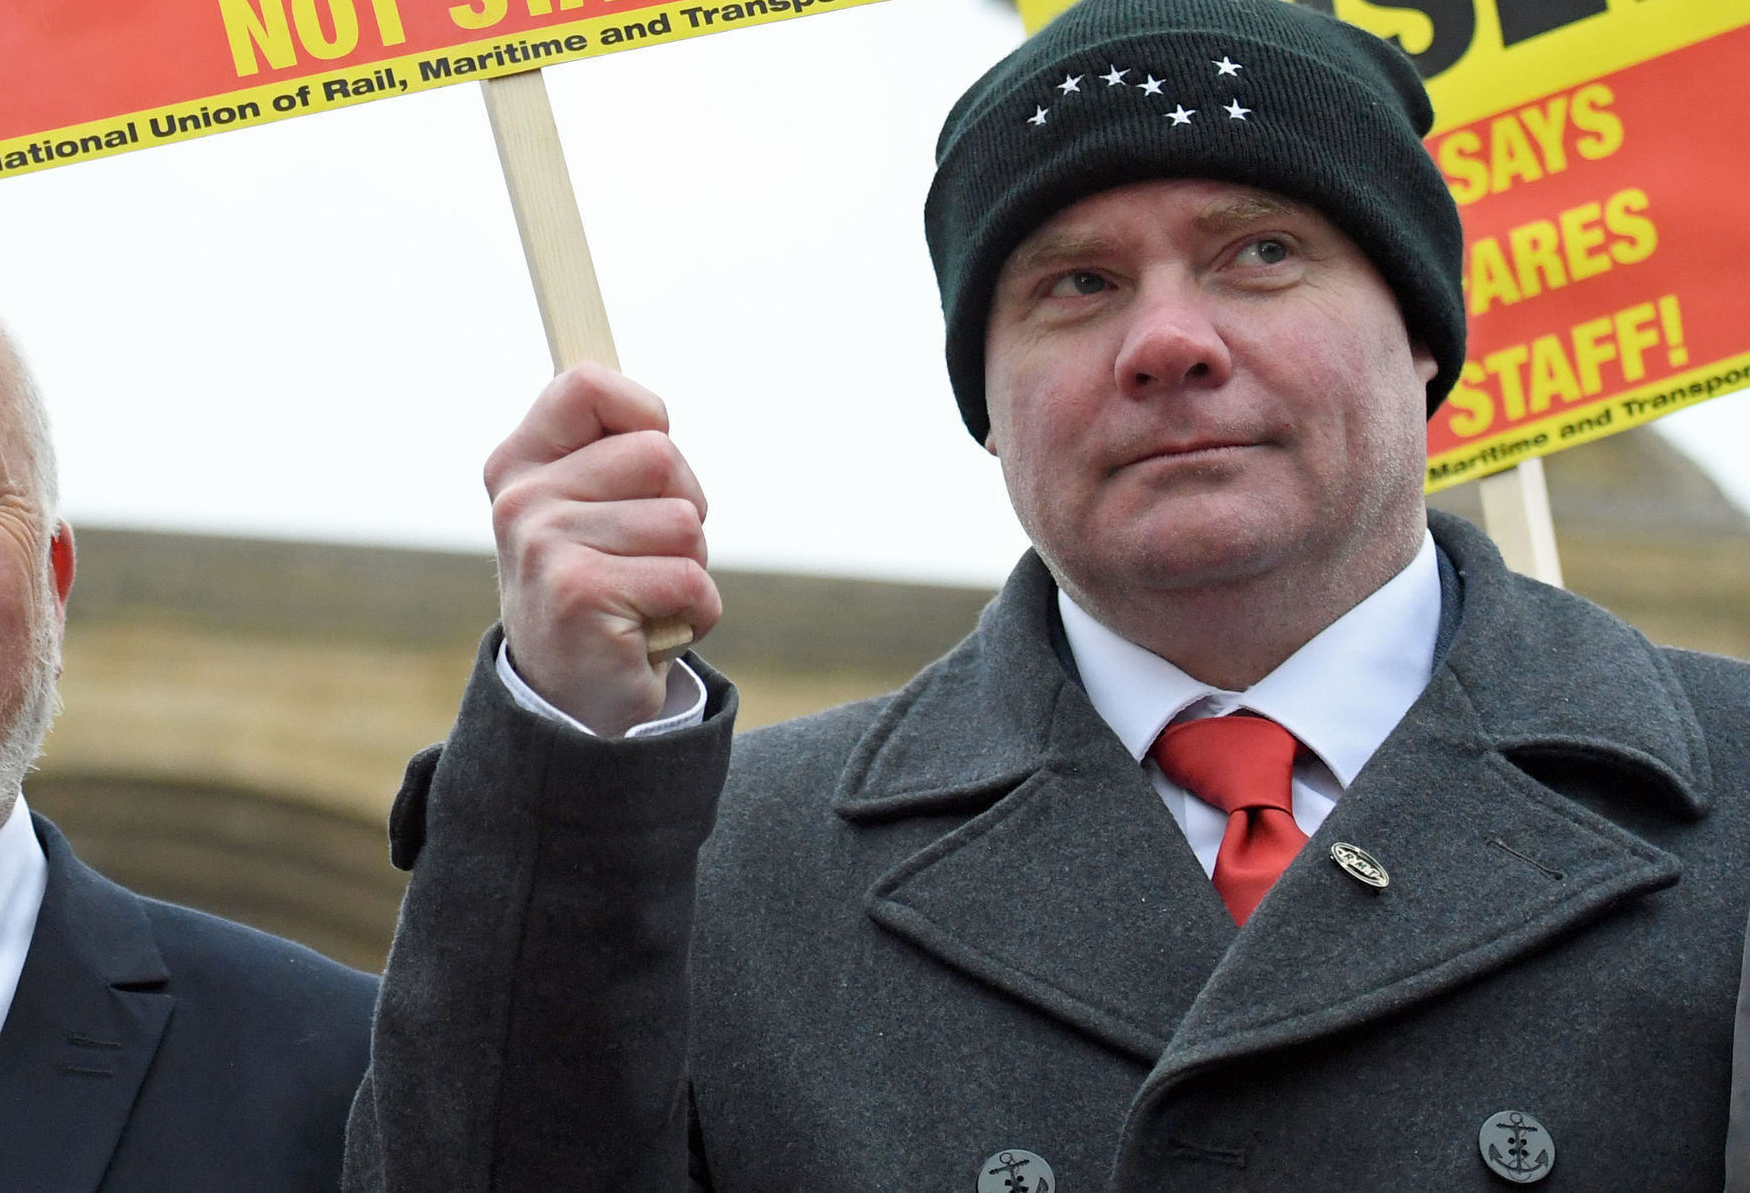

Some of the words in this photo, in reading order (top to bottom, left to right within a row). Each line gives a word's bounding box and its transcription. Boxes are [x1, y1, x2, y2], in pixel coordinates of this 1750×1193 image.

[150, 103, 260, 137] Union
[273, 86, 310, 111] of
[323, 68, 407, 101] Rail,
[419, 35, 587, 81] Maritime
[601, 13, 671, 45] and
[1439, 85, 1623, 206] SAYS
[1461, 187, 1659, 316] ARES
[1428, 433, 1548, 481] Maritime
[1560, 409, 1612, 439] and
[1622, 365, 1750, 416] Transpor
[1447, 293, 1689, 438] STAFF!
